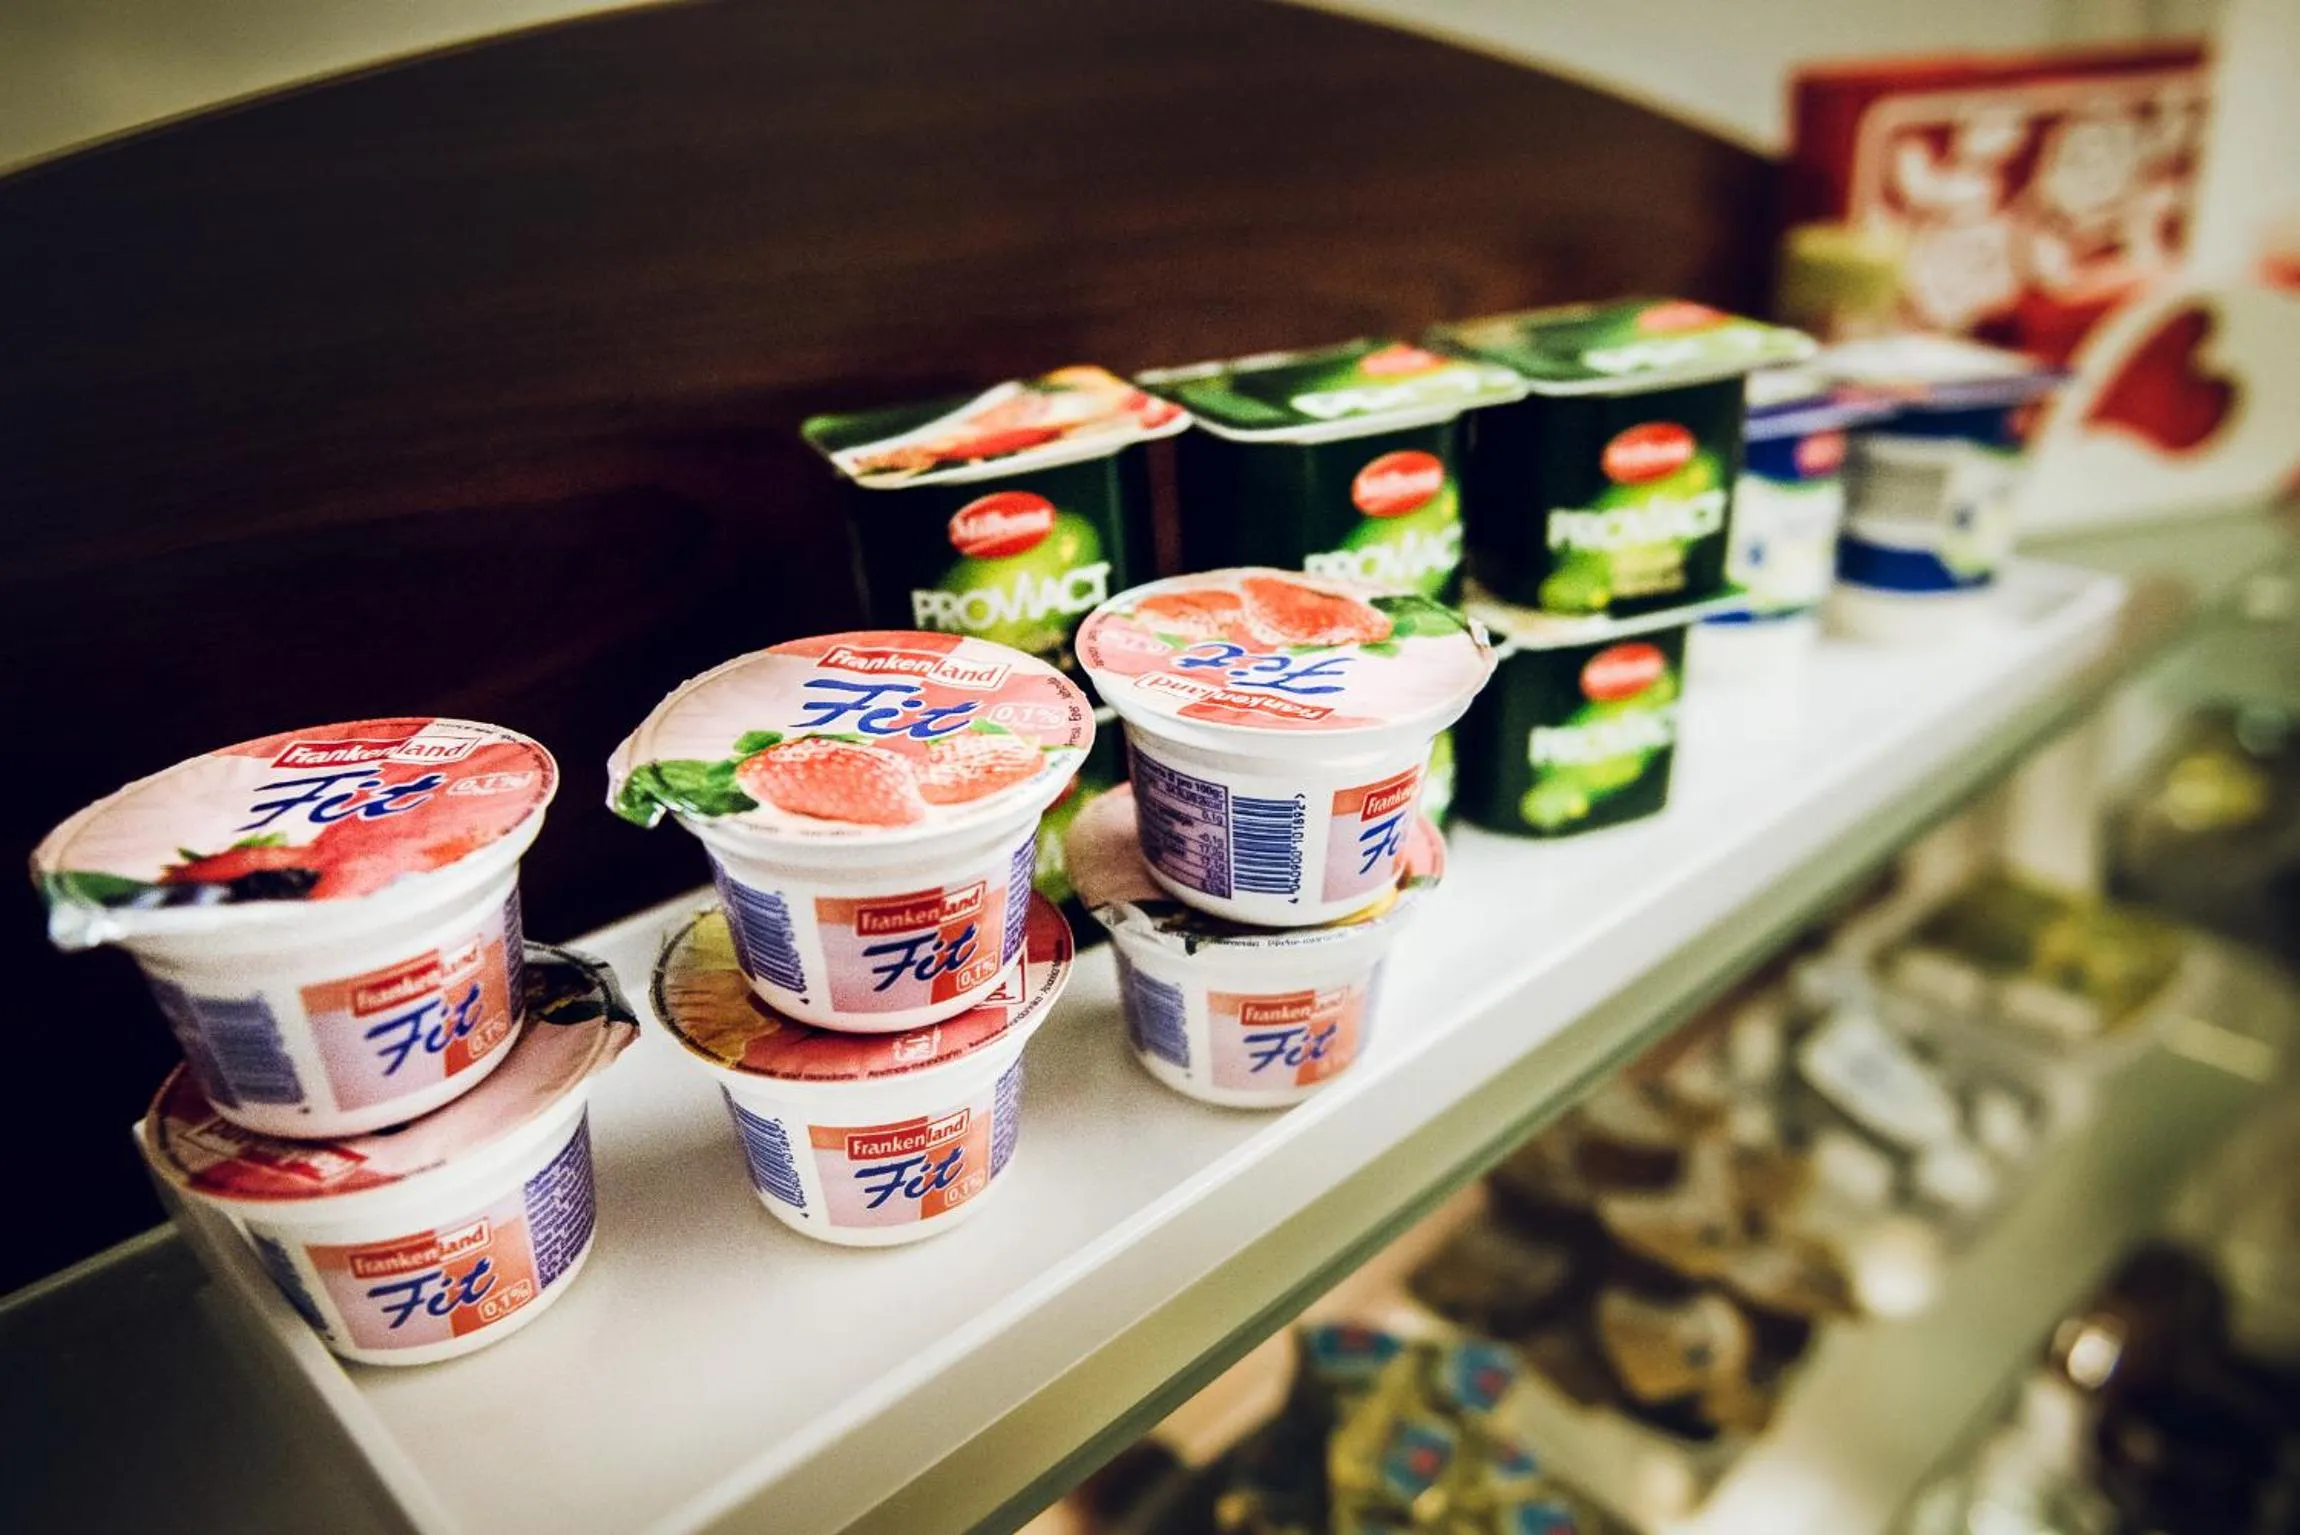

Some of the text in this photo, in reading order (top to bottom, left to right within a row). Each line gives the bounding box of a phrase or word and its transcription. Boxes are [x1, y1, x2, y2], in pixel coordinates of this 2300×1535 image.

[829, 649, 997, 682] Frankenland
[1177, 643, 1356, 694] Fit
[788, 679, 979, 737] Fit
[1149, 675, 1323, 718] Frankenland
[287, 740, 465, 764] Frankenland
[235, 769, 443, 832] Fit
[861, 887, 980, 930] Frankenland
[861, 922, 977, 992] Fit
[363, 982, 483, 1077] Fit
[1243, 1023, 1337, 1074] Fit
[853, 1115, 964, 1156] Frankenland
[854, 1143, 964, 1210] Fit
[354, 1226, 485, 1276] Frankenland
[366, 1257, 496, 1329] Fit
